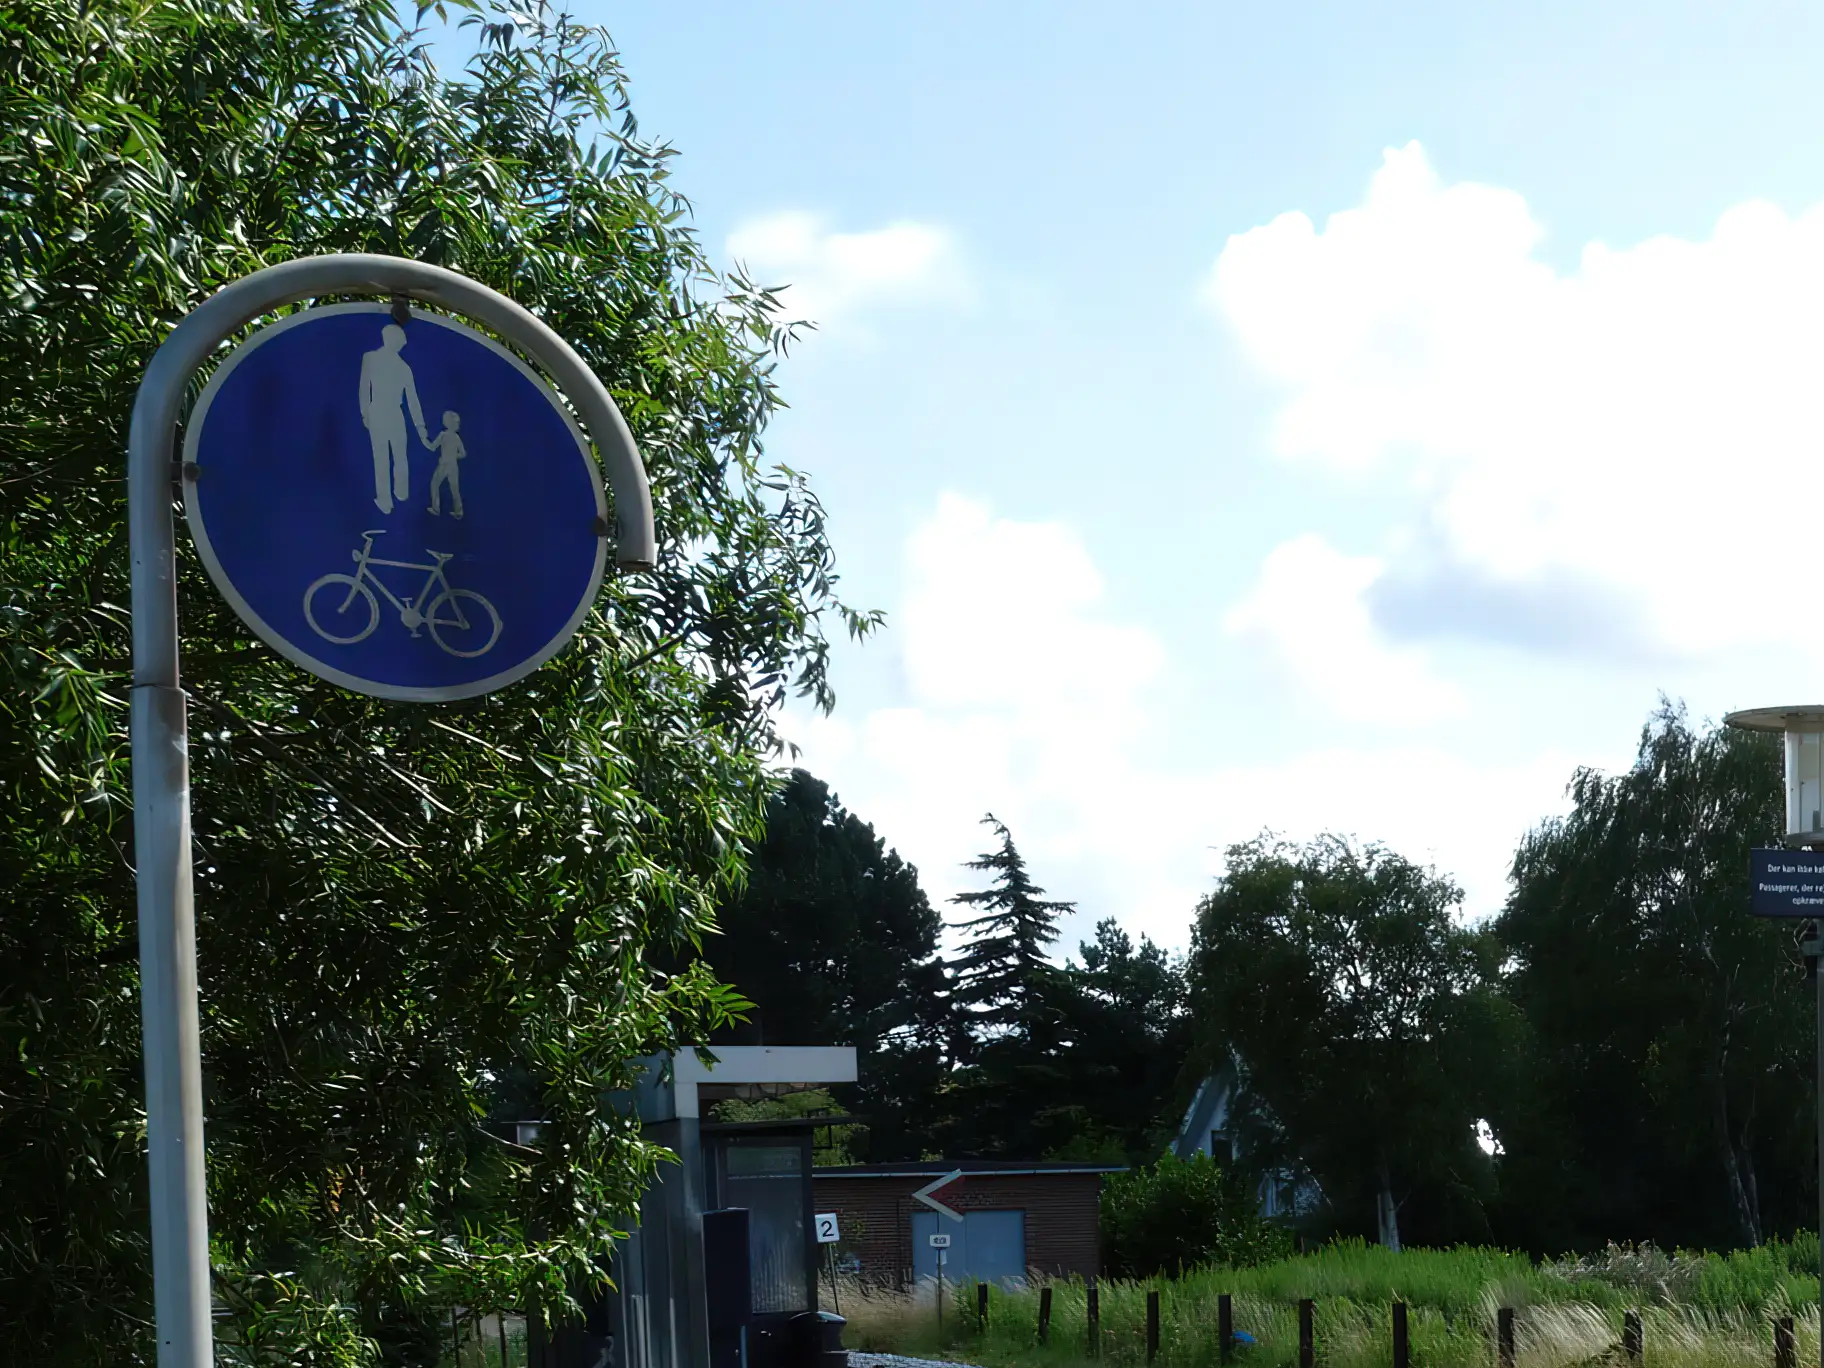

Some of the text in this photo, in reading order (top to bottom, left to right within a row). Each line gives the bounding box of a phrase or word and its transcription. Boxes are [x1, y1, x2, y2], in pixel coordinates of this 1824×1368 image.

[1767, 863, 1781, 873] Der
[1782, 864, 1796, 873] kan
[1797, 864, 1813, 873] ikke
[1758, 882, 1800, 894] Passagerer,
[1801, 883, 1814, 893] der
[821, 1220, 835, 1237] 2
